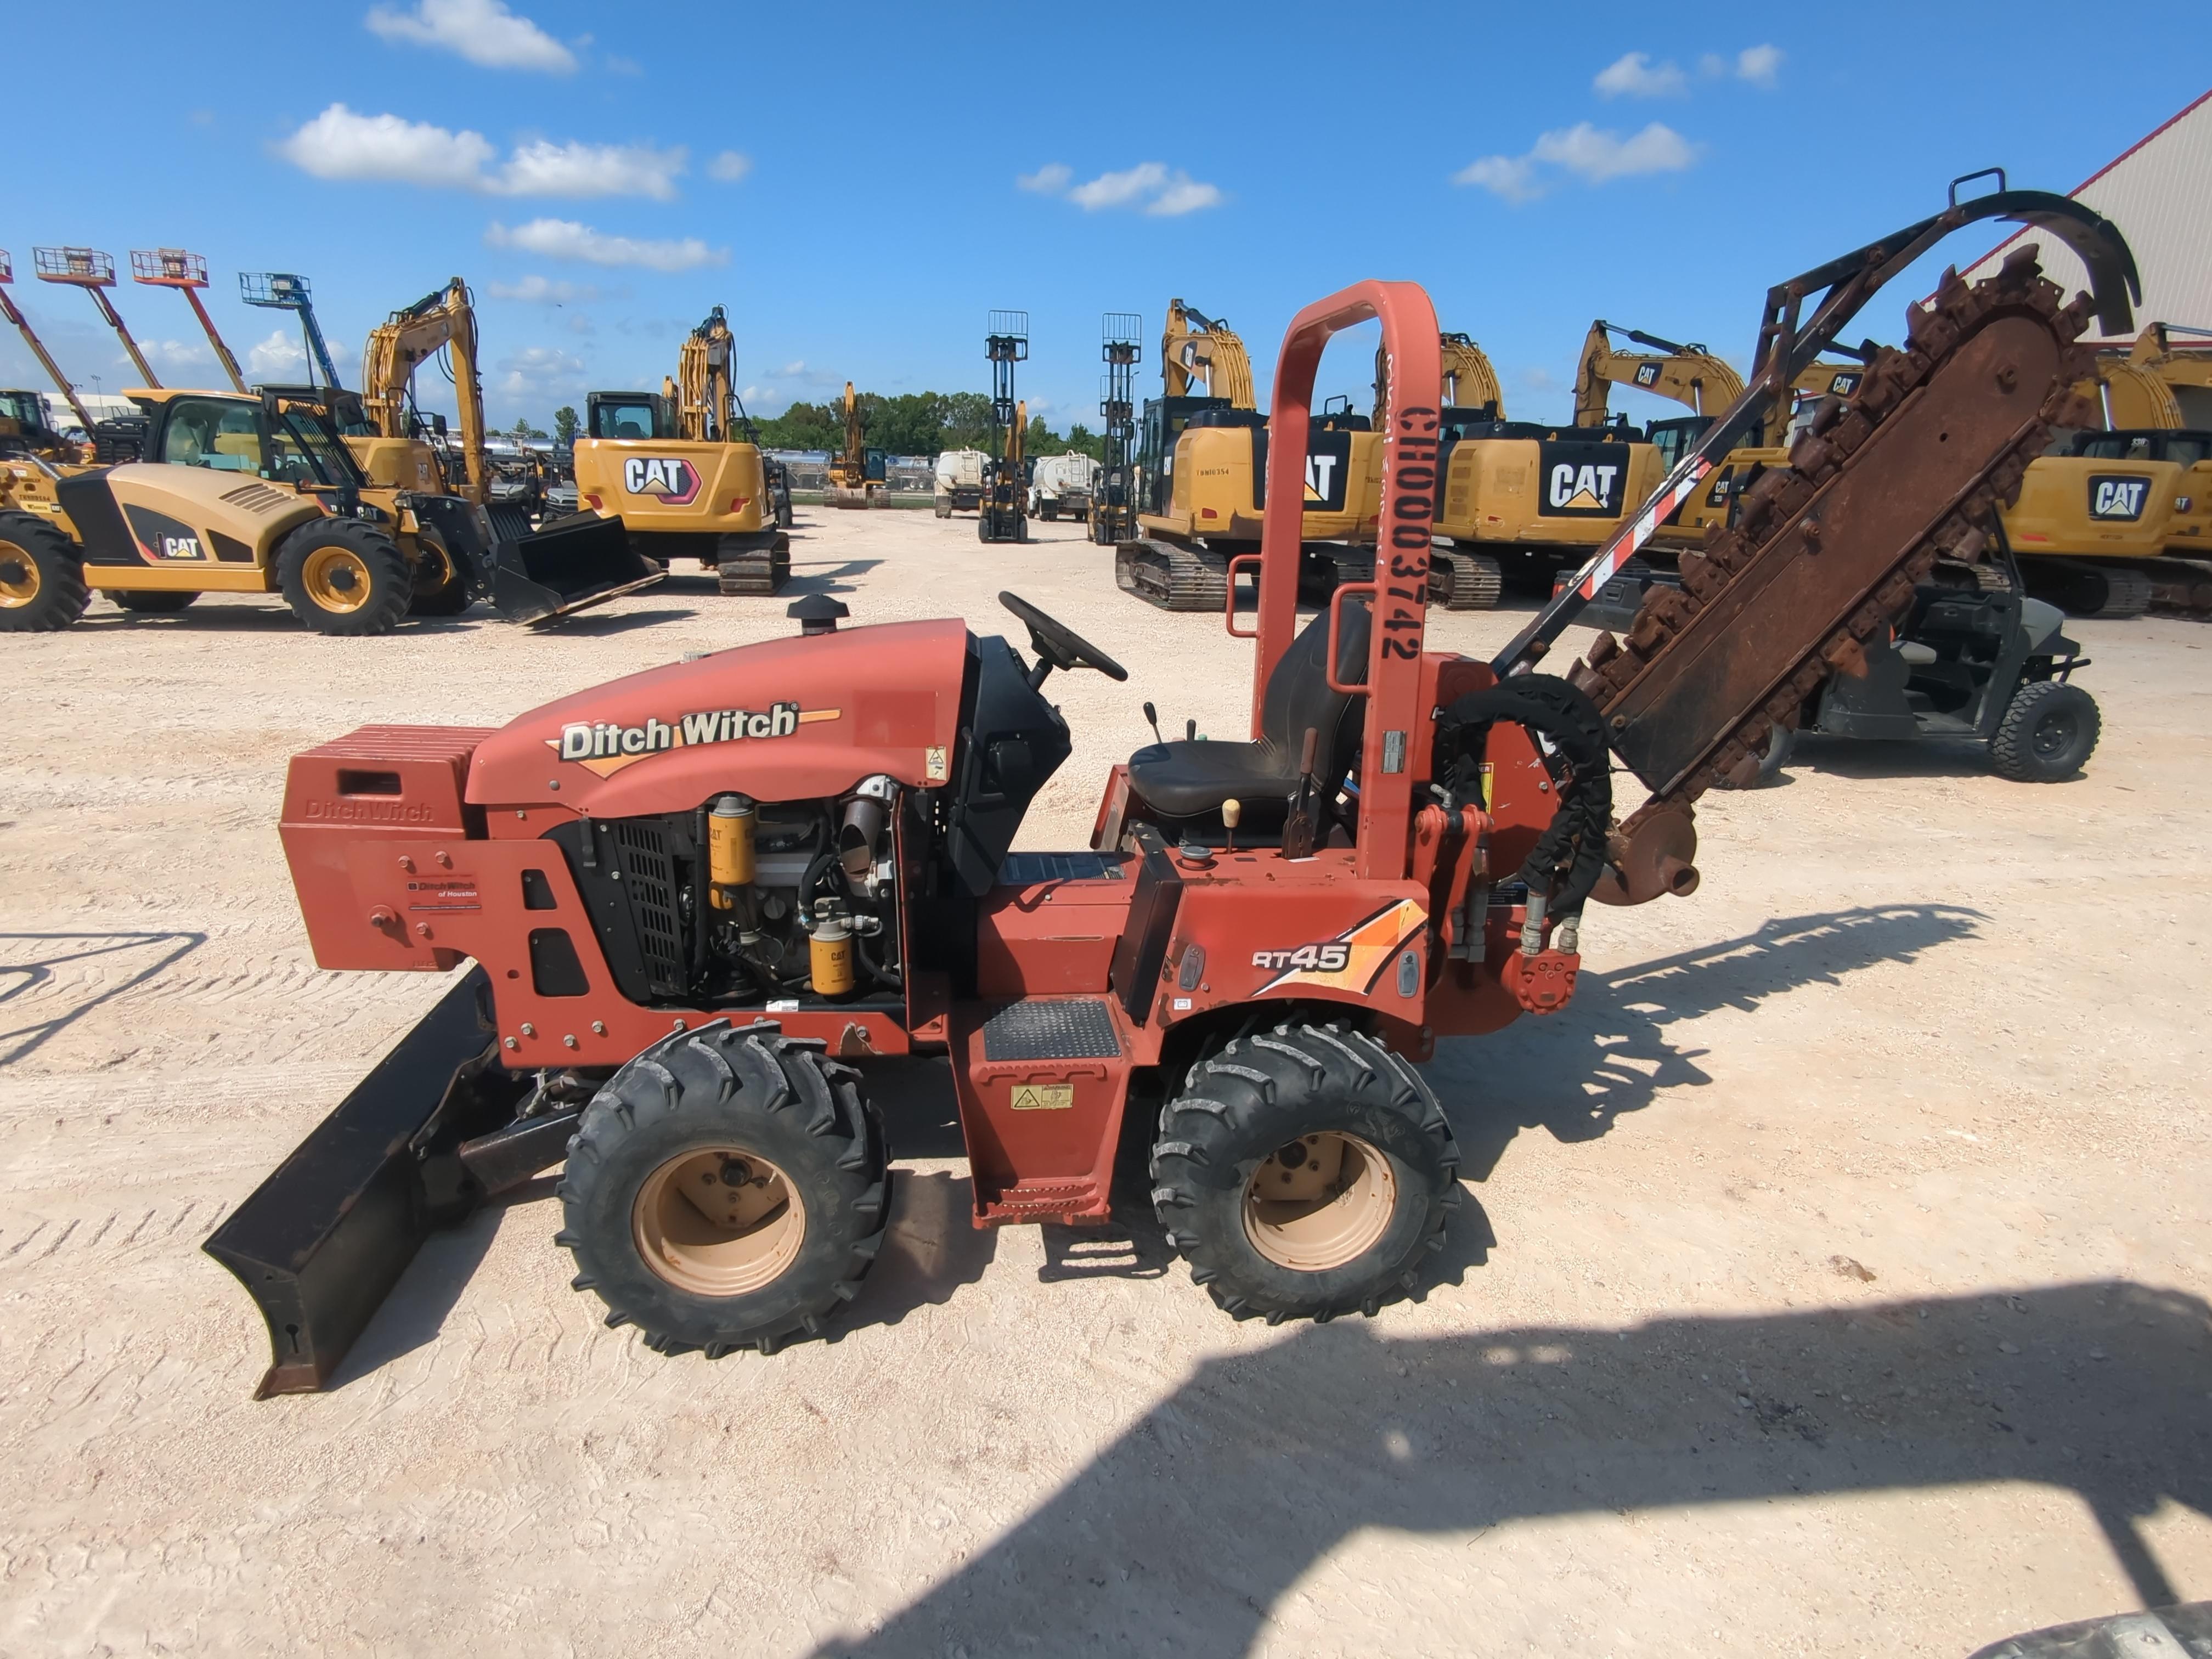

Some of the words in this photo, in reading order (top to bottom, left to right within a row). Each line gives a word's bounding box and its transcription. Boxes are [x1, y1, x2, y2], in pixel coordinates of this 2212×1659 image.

[1638, 366, 1655, 385] CAT
[1833, 376, 1853, 394] CAT
[625, 458, 682, 494] CAT
[1304, 455, 1337, 501] AT
[1549, 464, 1617, 509] CAT
[1714, 481, 1730, 494] CAT
[2095, 482, 2143, 516] CAT
[2174, 497, 2188, 511] AT
[357, 506, 378, 521] CAT
[1381, 407, 1438, 659] CH0003742
[165, 537, 198, 557] CAT
[563, 718, 670, 760] Ditch
[682, 704, 793, 747] Witch
[305, 799, 366, 820] Ditch
[368, 800, 435, 822] Witch
[831, 950, 846, 961] CAT
[1251, 945, 1347, 969] RT45
